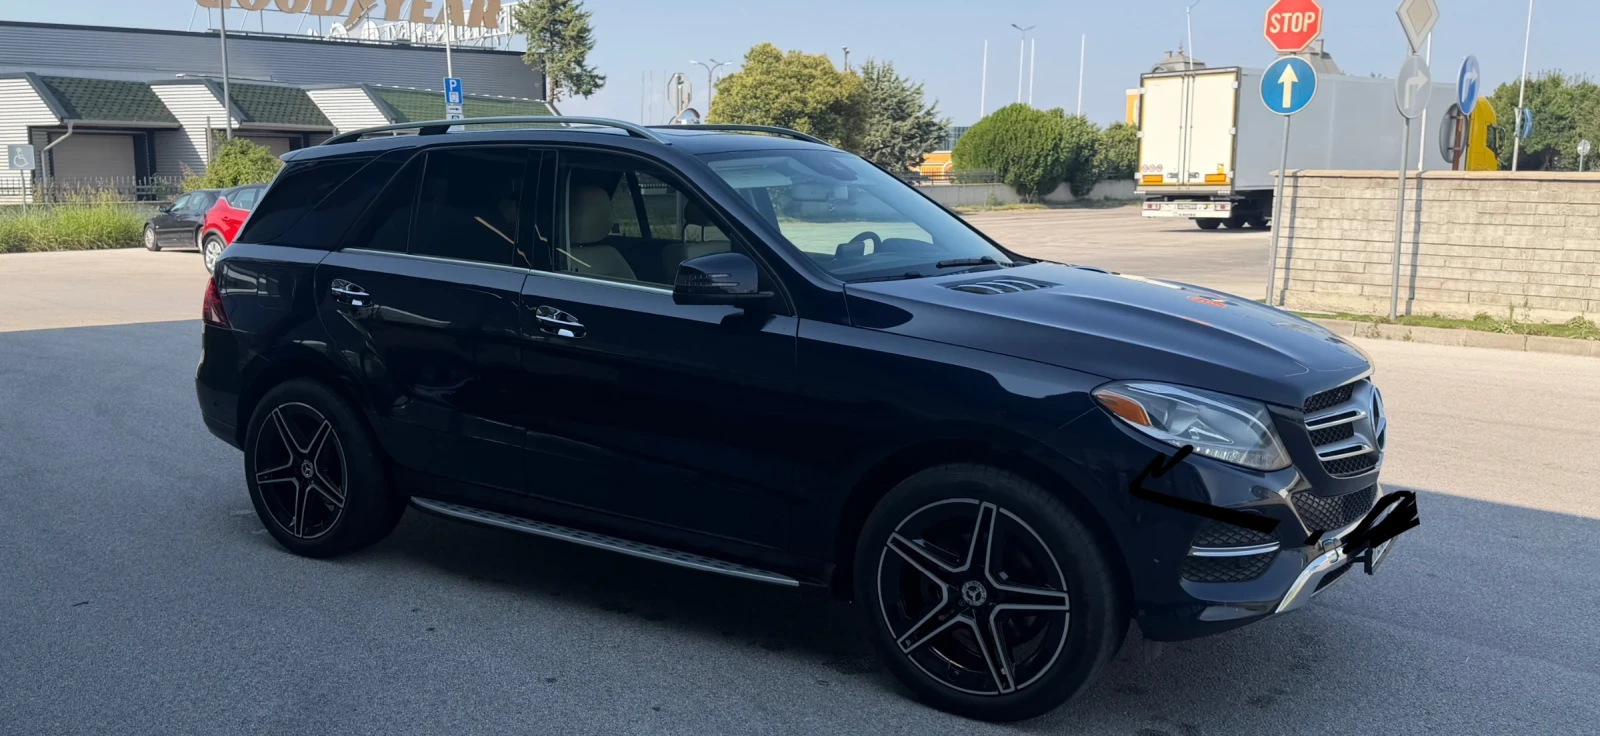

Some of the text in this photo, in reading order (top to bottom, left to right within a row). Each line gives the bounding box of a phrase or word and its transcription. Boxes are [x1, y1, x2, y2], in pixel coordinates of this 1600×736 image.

[196, 0, 501, 29] YEAR
[1269, 11, 1316, 34] STOP
[449, 79, 457, 92] P
